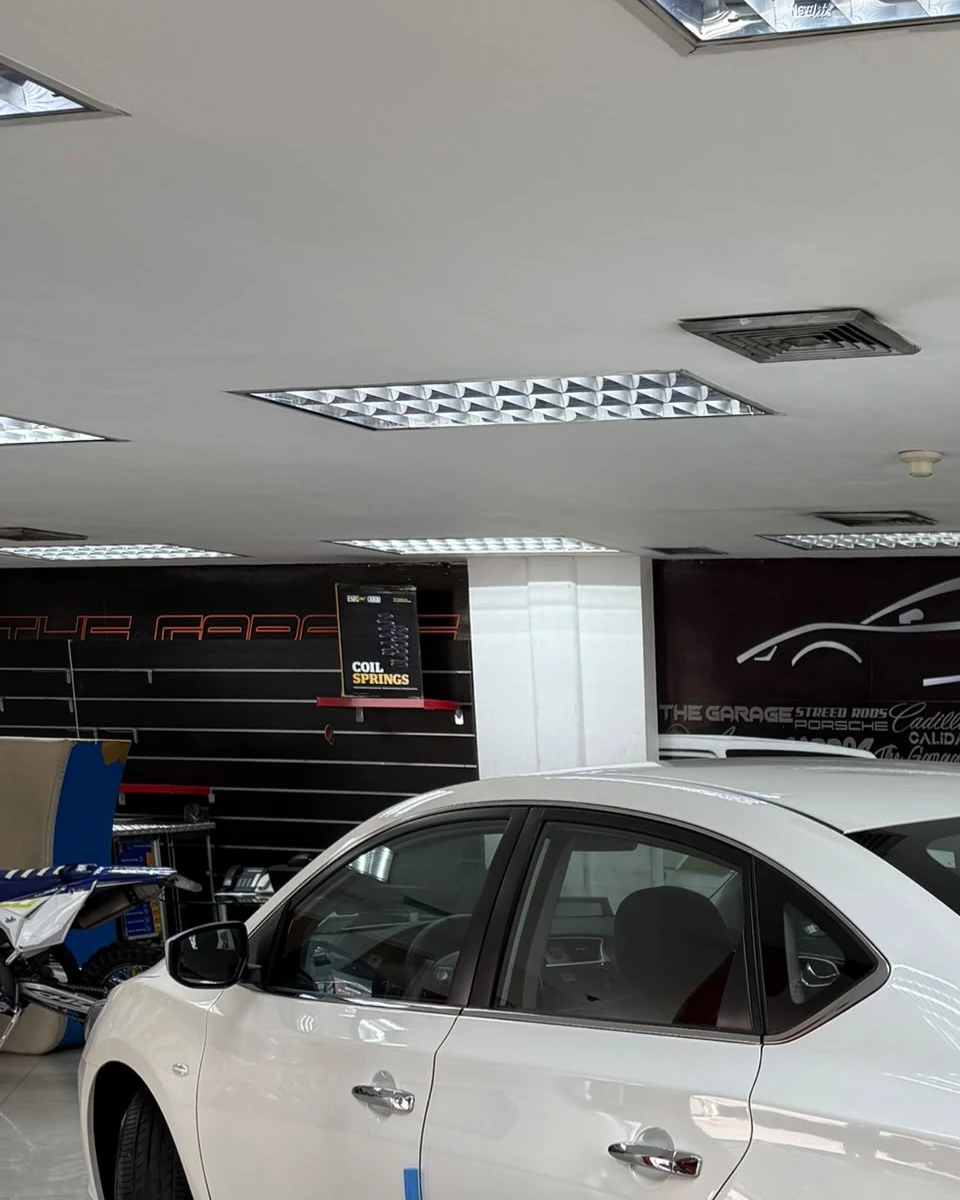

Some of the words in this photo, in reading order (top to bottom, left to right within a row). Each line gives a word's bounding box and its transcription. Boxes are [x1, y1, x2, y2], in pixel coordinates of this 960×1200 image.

[352, 661, 384, 673] COIL
[352, 673, 410, 685] SPRINGS
[659, 704, 704, 722] THE
[705, 705, 794, 723] GARAGE
[794, 707, 848, 718] STREED
[851, 707, 888, 718] RODS
[794, 721, 889, 732] PORSCHE
